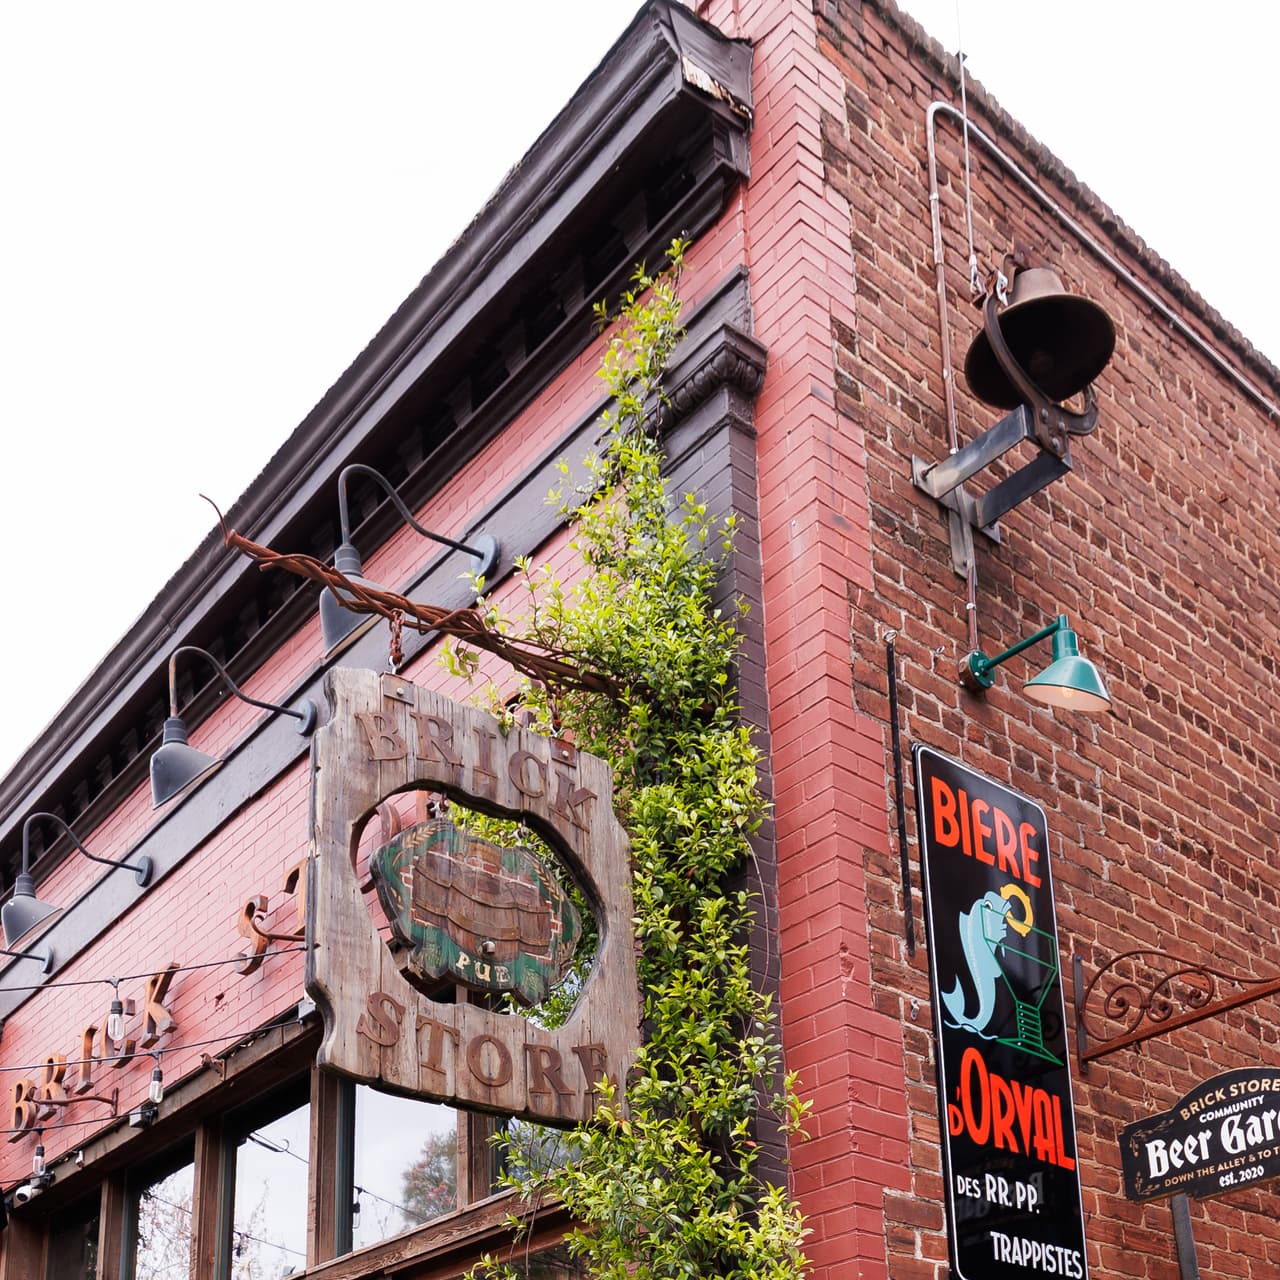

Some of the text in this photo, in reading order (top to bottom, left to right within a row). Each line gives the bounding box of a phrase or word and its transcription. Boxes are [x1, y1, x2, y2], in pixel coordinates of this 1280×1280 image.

[354, 711, 598, 835] BRICK
[930, 775, 1042, 889] BIERE
[456, 951, 511, 983] PUB
[7, 962, 180, 1144] BRICK
[356, 991, 618, 1098] STORE
[1179, 1088, 1227, 1121] BRICK
[1199, 1095, 1265, 1124] COMMUNITY
[1144, 1127, 1213, 1180] Beer
[1164, 1172, 1195, 1188] DOWN
[1197, 1165, 1216, 1178] THE
[1217, 1156, 1247, 1173] ALLEY
[1248, 1153, 1256, 1163] &
[1257, 1149, 1272, 1161] TO
[956, 1173, 1040, 1214] DES RR. PP.
[1218, 1165, 1265, 1188] est. 2020
[990, 1230, 1083, 1280] TRAPPISTES
